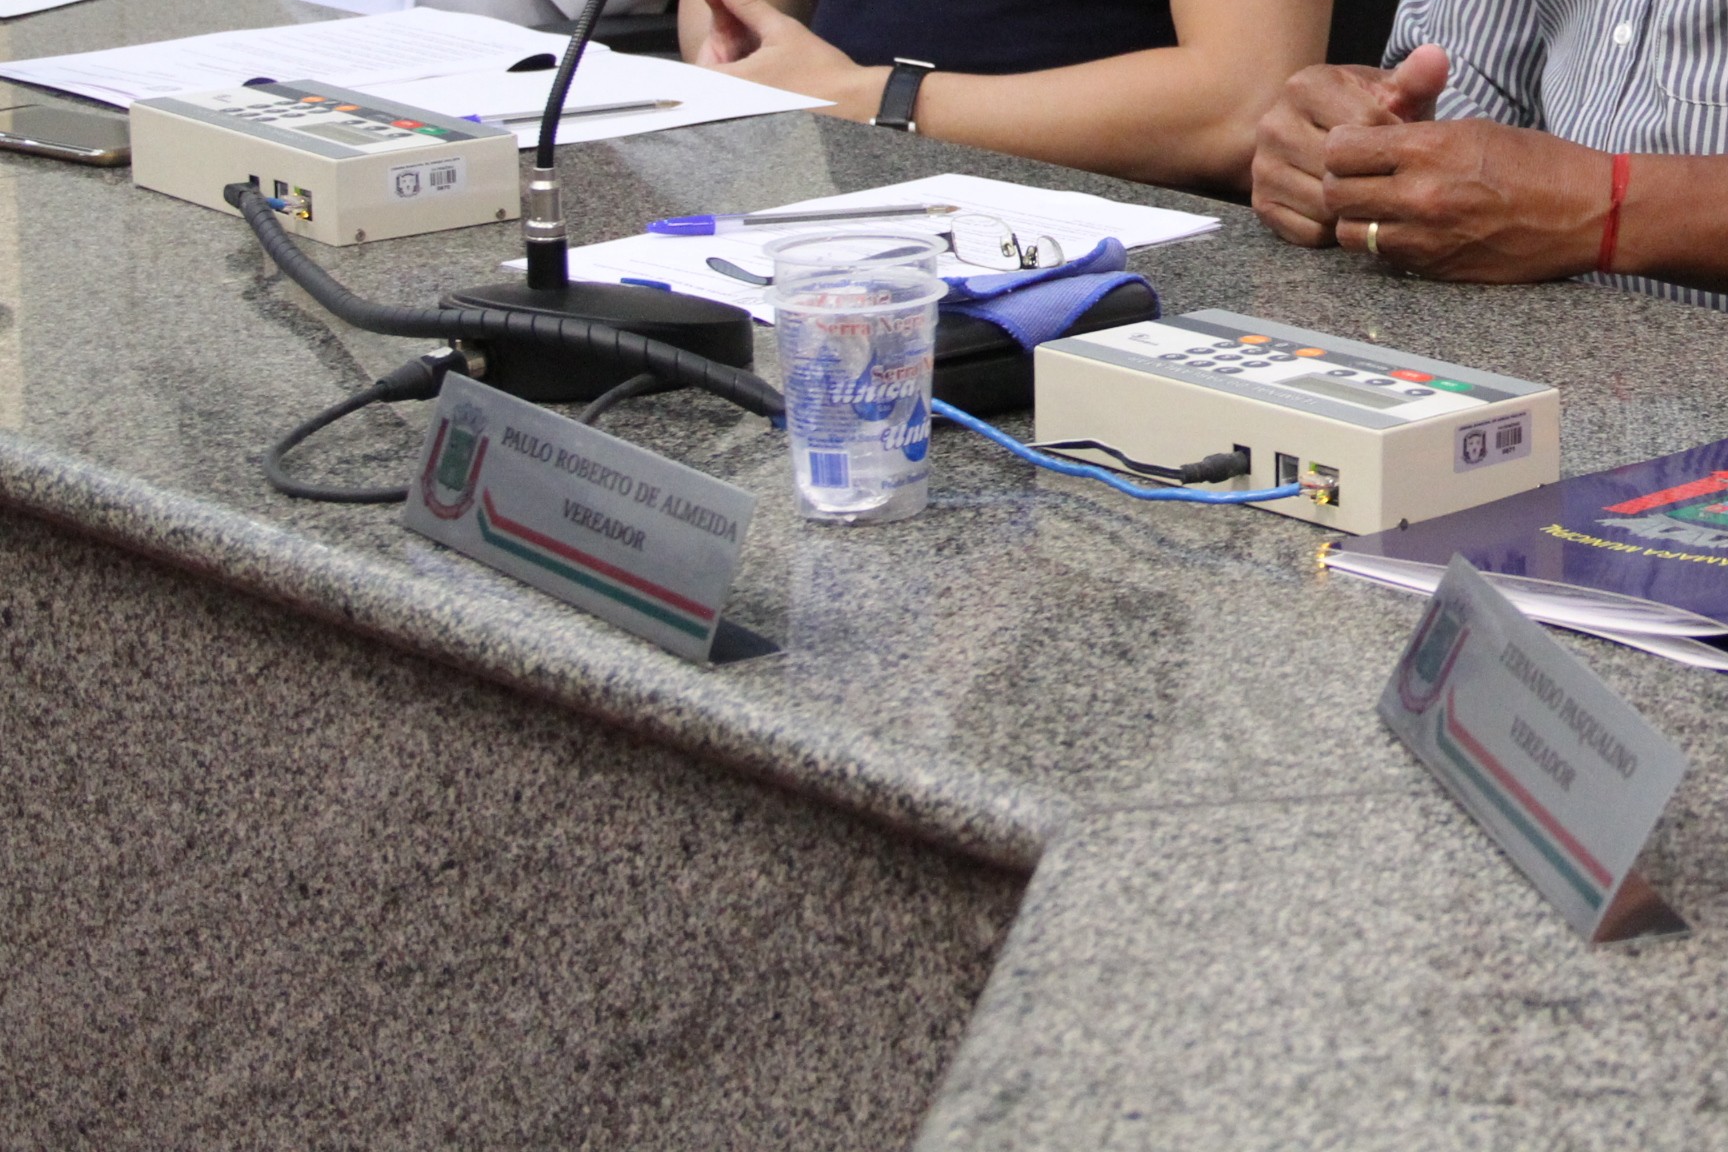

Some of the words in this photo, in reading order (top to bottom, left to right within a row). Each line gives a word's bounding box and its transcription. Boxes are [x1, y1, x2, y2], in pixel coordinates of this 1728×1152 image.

[501, 426, 552, 463] PAULO
[555, 448, 633, 497] ROBERTO
[634, 481, 661, 509] DE
[659, 494, 738, 543] ALMEIDA
[562, 498, 647, 551] VEREADOR
[1539, 523, 1643, 553] MUNICIPAL
[1500, 640, 1564, 710] FERNANDO
[1558, 697, 1638, 780] PASQUALINO
[1509, 714, 1577, 792] VEREADOR
